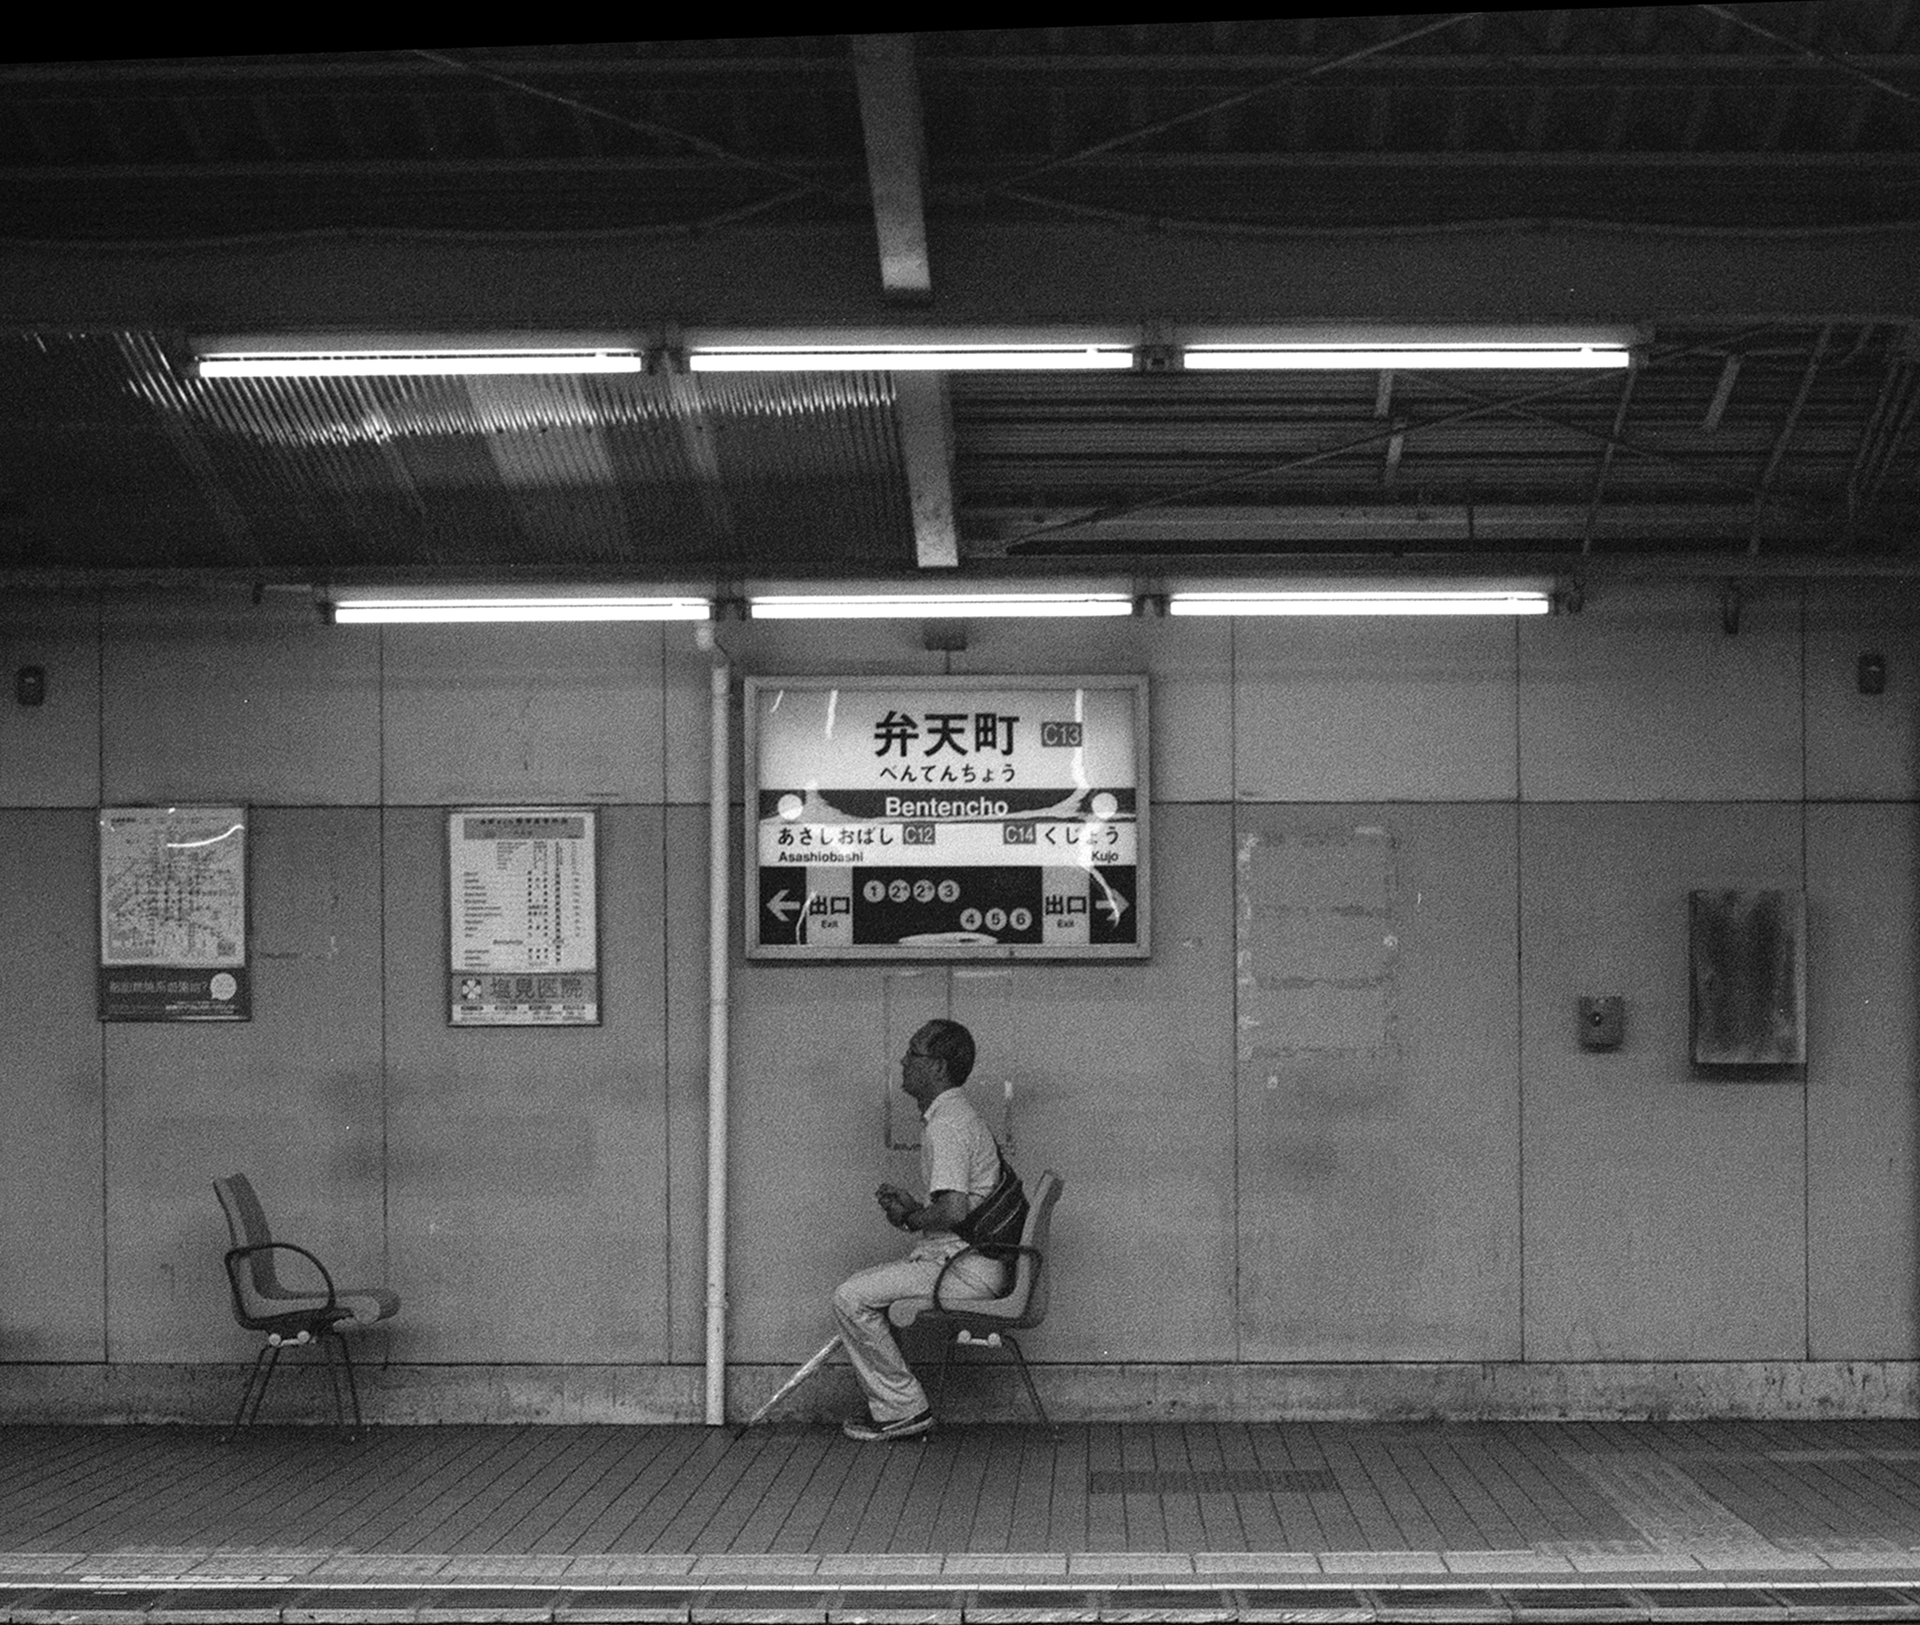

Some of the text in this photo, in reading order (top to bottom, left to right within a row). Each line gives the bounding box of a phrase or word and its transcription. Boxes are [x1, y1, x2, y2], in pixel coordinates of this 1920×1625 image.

[874, 710, 1020, 757] 弁天町
[1043, 723, 1080, 745] C13
[880, 763, 1016, 783] べんてんちょう
[885, 796, 1009, 817] Bentencho
[778, 827, 894, 846] あさしおばし
[904, 827, 934, 843] C12
[1005, 825, 1035, 843] C14
[778, 851, 864, 863] Asashiobashi
[1091, 850, 1119, 864] Kujo
[809, 896, 850, 916] 出口
[1045, 895, 1087, 915] 出口
